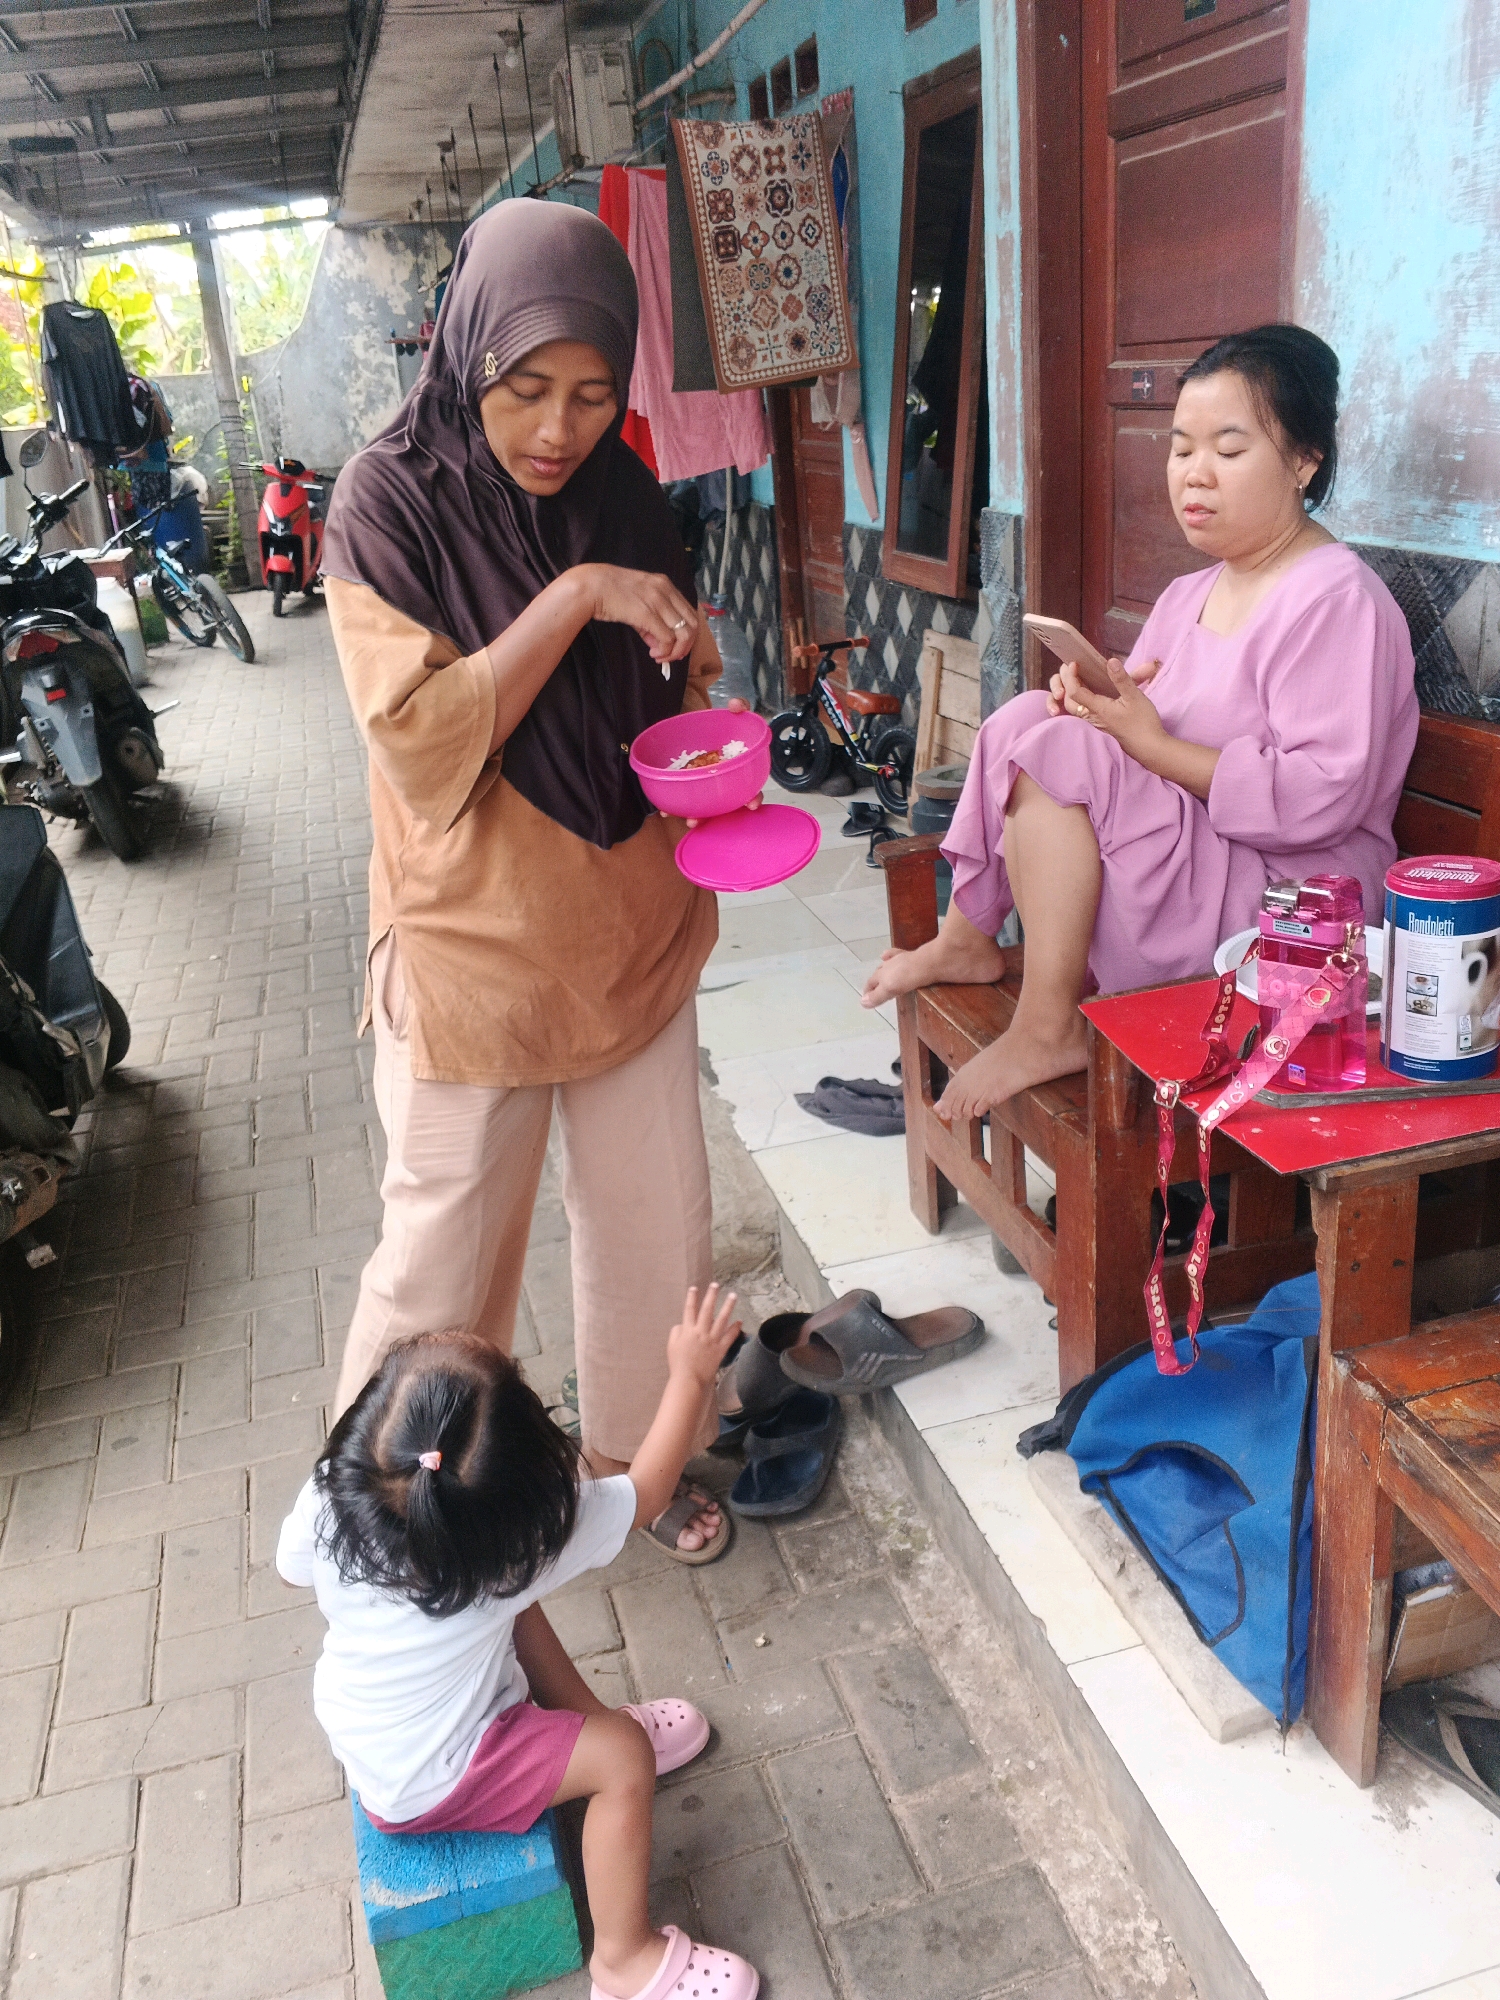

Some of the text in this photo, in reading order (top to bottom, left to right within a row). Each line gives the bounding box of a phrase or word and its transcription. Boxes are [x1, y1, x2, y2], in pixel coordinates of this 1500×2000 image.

[1408, 911, 1455, 936] Rondoletti
[1210, 983, 1233, 1034] LOTSO
[1199, 1099, 1230, 1153] LOTSO
[1150, 1274, 1165, 1329] LOTSO
